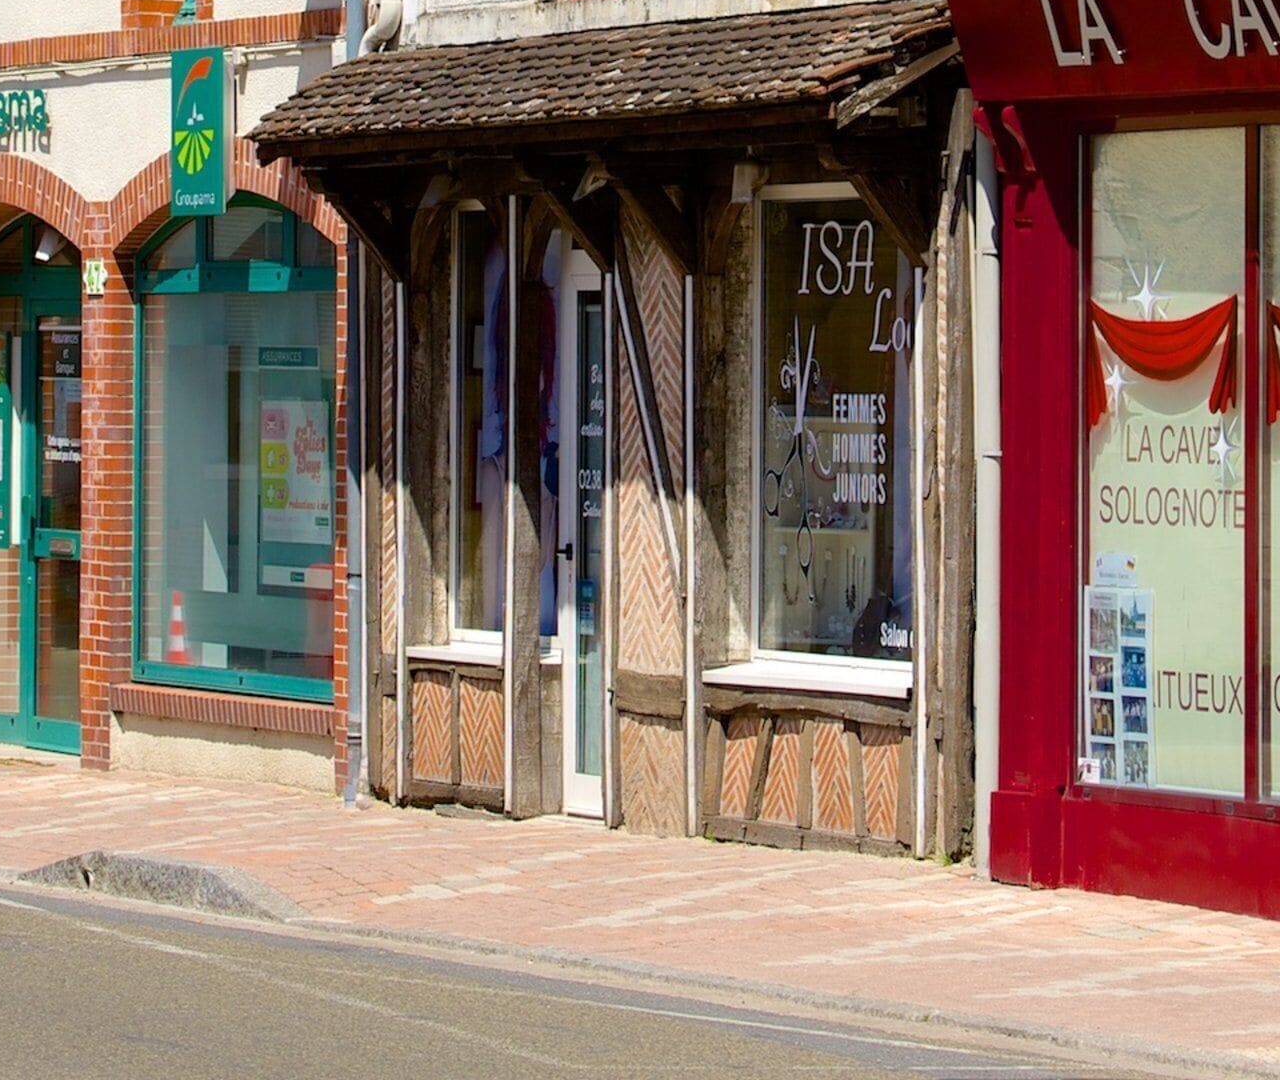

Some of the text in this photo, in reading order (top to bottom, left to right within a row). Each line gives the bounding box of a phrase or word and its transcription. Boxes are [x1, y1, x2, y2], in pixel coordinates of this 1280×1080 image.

[175, 188, 216, 209] Groupama
[797, 219, 874, 296] ISA
[832, 393, 887, 424] FEMMES
[832, 434, 887, 465] HOMMES
[1126, 424, 1154, 463] LA
[832, 473, 887, 506] JUNIORS
[1099, 485, 1245, 529] SOLOGNOTE
[879, 621, 908, 650] Salon
[1153, 671, 1244, 715] ITUEUX
